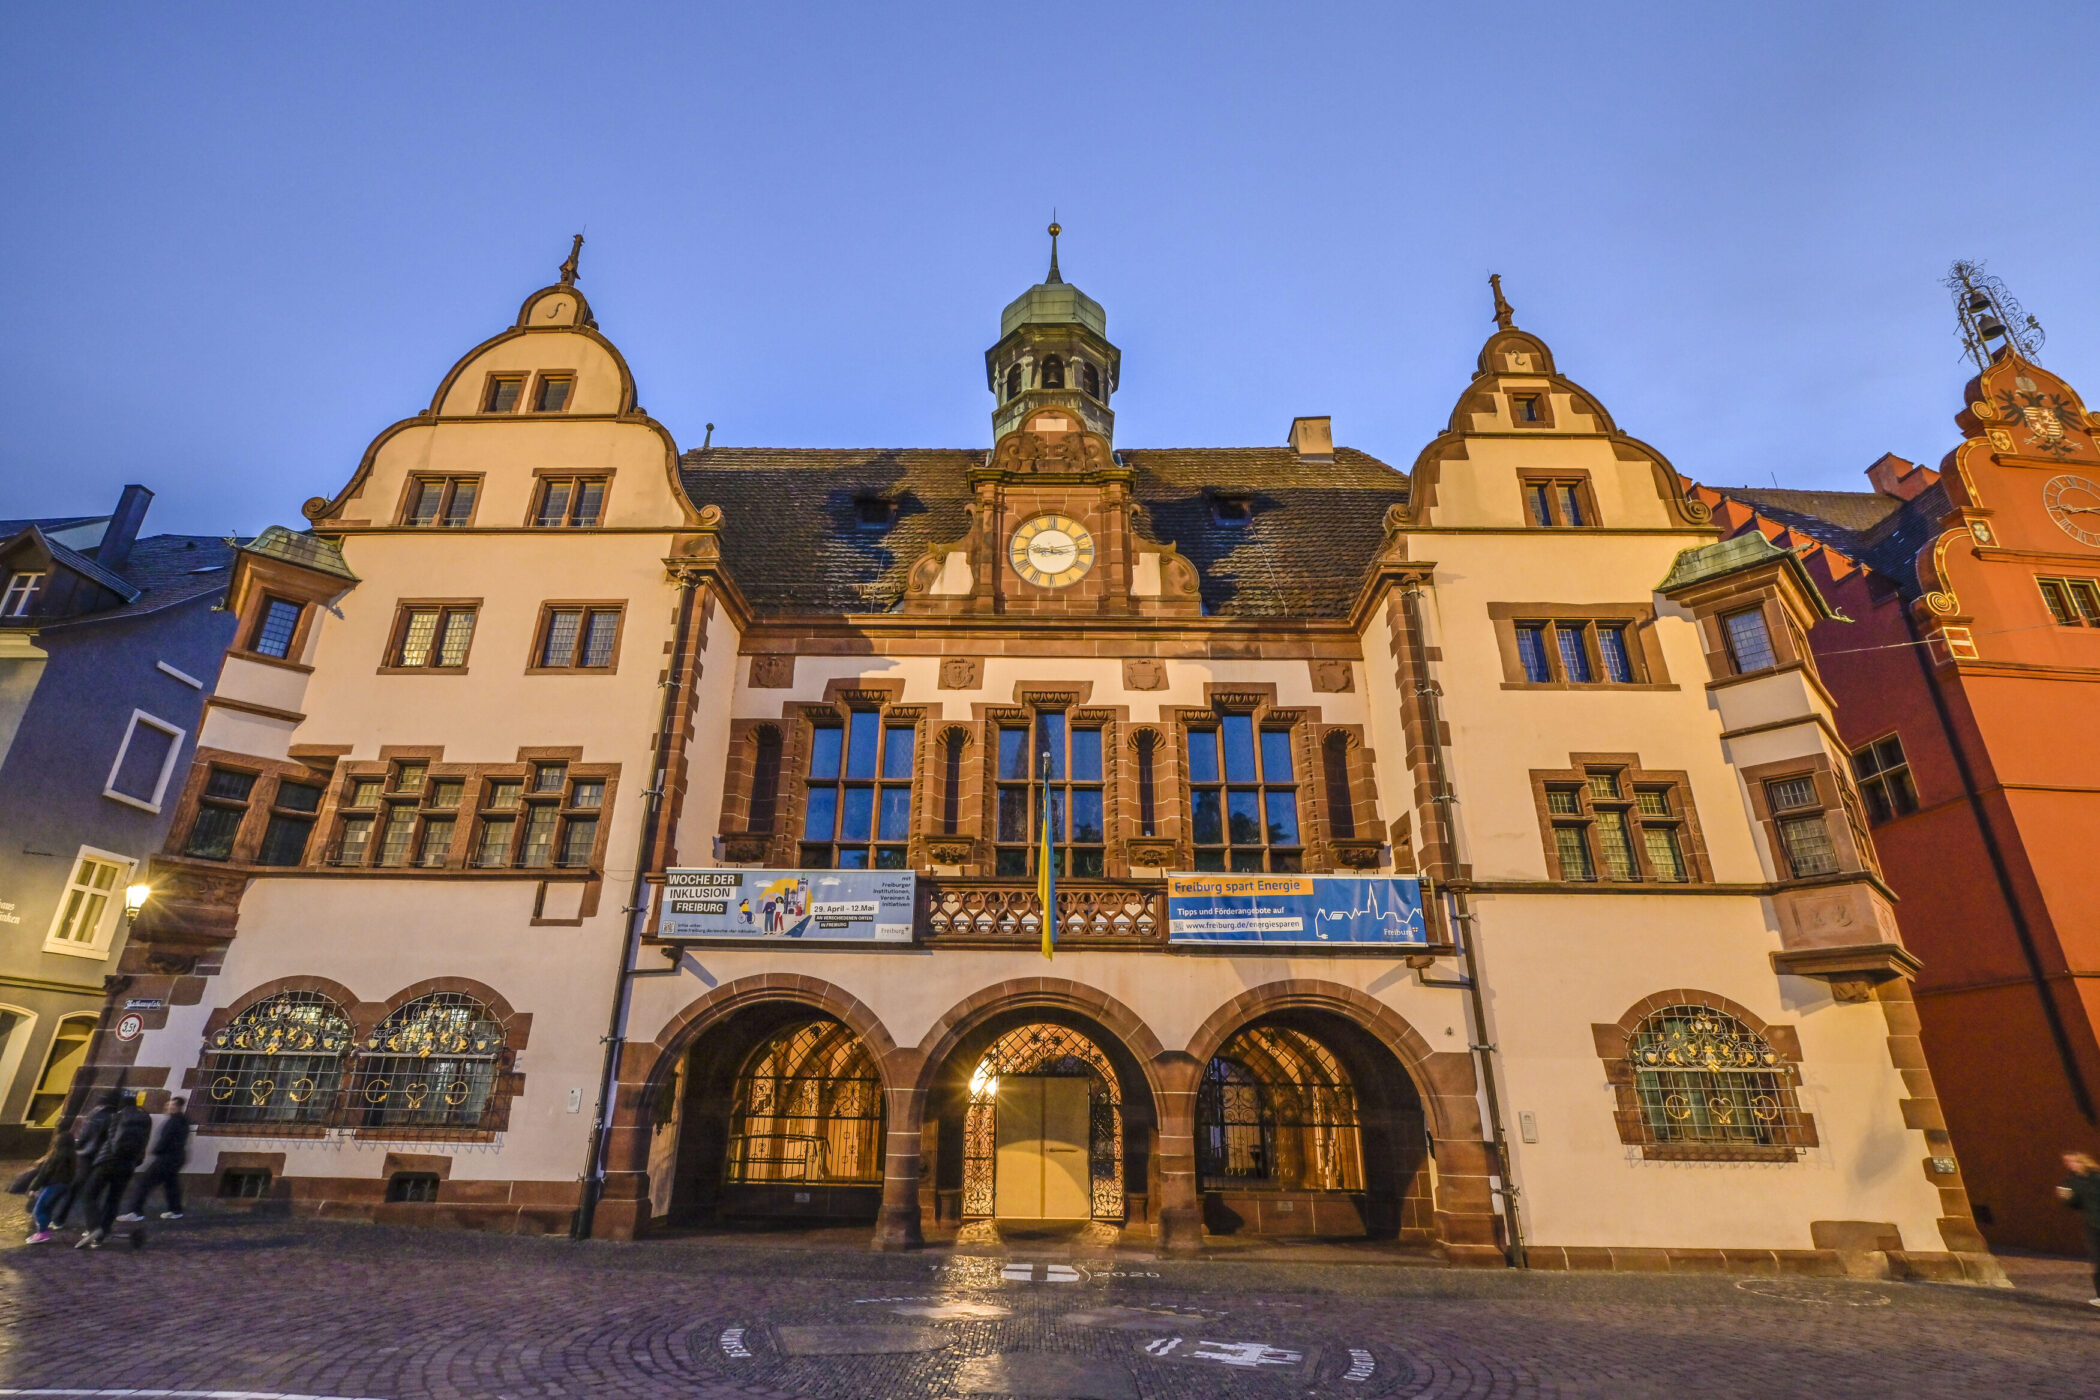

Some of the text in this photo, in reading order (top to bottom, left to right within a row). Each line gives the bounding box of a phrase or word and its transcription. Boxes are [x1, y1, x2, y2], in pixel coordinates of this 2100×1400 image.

[669, 874, 735, 885] WOCHE DER
[1175, 879, 1301, 894] Freiburg spart Energie
[670, 887, 730, 899] INKLUSION
[676, 902, 724, 912] FREIBURG
[814, 905, 826, 913] 29.
[827, 905, 845, 913] April
[1177, 906, 1285, 916] Tipps und Förderangebote auf
[1186, 920, 1300, 931] www.freiburg.de/energiesparen
[880, 927, 905, 935] Freiburg
